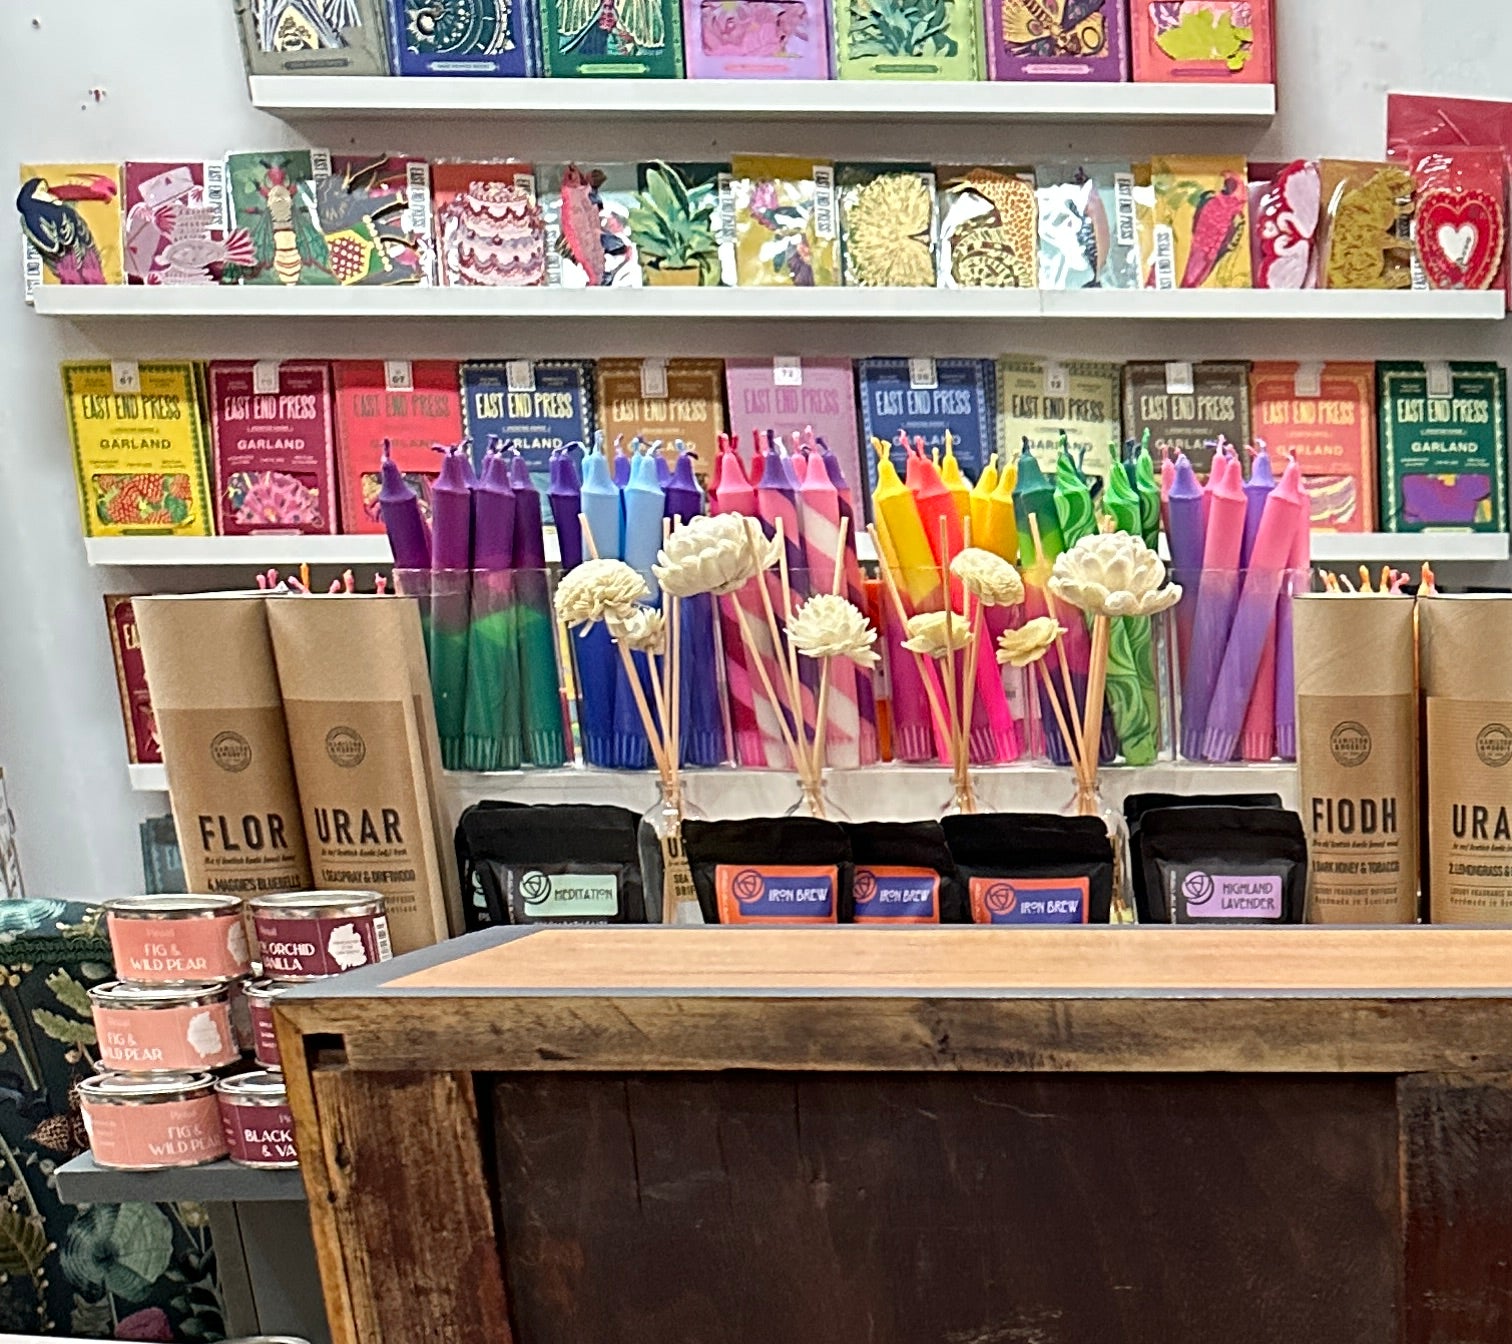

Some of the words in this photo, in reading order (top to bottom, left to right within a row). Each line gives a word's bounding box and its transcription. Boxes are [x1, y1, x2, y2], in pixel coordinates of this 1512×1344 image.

[82, 394, 111, 420] EAST
[114, 395, 138, 420] END
[141, 394, 181, 420] PRESS
[225, 396, 250, 421] EAST
[253, 396, 276, 420] END
[279, 395, 317, 420] PRESS
[353, 394, 380, 419] EAST
[385, 393, 408, 418] END
[412, 394, 449, 418] PRESS
[475, 393, 505, 420] EAST
[507, 392, 532, 418] END
[534, 392, 573, 420] PRESS
[743, 389, 772, 414] EAST
[775, 389, 798, 414] END
[802, 388, 839, 415] PRESS
[876, 390, 904, 416] EAST
[907, 390, 930, 415] END
[933, 390, 971, 416] PRESS
[1012, 395, 1039, 420] EAST
[1043, 396, 1065, 421] END
[1068, 396, 1104, 422] PRESS
[1141, 395, 1168, 421] EAST
[1172, 395, 1195, 421] END
[1198, 396, 1235, 421] PRESS
[612, 398, 642, 423] EAST
[643, 398, 667, 422] END
[669, 398, 707, 422] PRESS
[1263, 400, 1289, 425] EAST
[1293, 400, 1315, 425] END
[1318, 400, 1355, 426] PRESS
[1397, 398, 1424, 423] EAST
[1428, 398, 1450, 423] END
[1452, 398, 1489, 423] PRESS
[100, 438, 171, 450] GARLAND
[237, 438, 305, 450] GARLAND
[1411, 441, 1479, 453] GARLAND
[1311, 797, 1397, 835] FIODH
[198, 813, 288, 851] FLOR
[314, 807, 403, 845] URAR
[554, 888, 613, 901] MEDITATION
[768, 888, 794, 903] IRON
[796, 887, 829, 902] BREW
[879, 889, 902, 904] IRON
[903, 888, 930, 903] BREW
[1222, 882, 1272, 895] HIGHLAND
[1020, 900, 1044, 914] IRON
[1046, 900, 1079, 914] BREW
[1221, 897, 1276, 910] LAVENDER
[144, 943, 168, 956] FIG
[170, 943, 182, 956] &
[269, 942, 316, 956] ORCHID
[129, 957, 164, 972] WILD
[166, 957, 208, 971] PEAR
[106, 1032, 125, 1046] FIG
[125, 1047, 164, 1061] PEAR
[168, 1126, 190, 1138] FIG
[244, 1129, 293, 1143] BLACK
[149, 1142, 188, 1156] WILD
[262, 1146, 273, 1157] &
